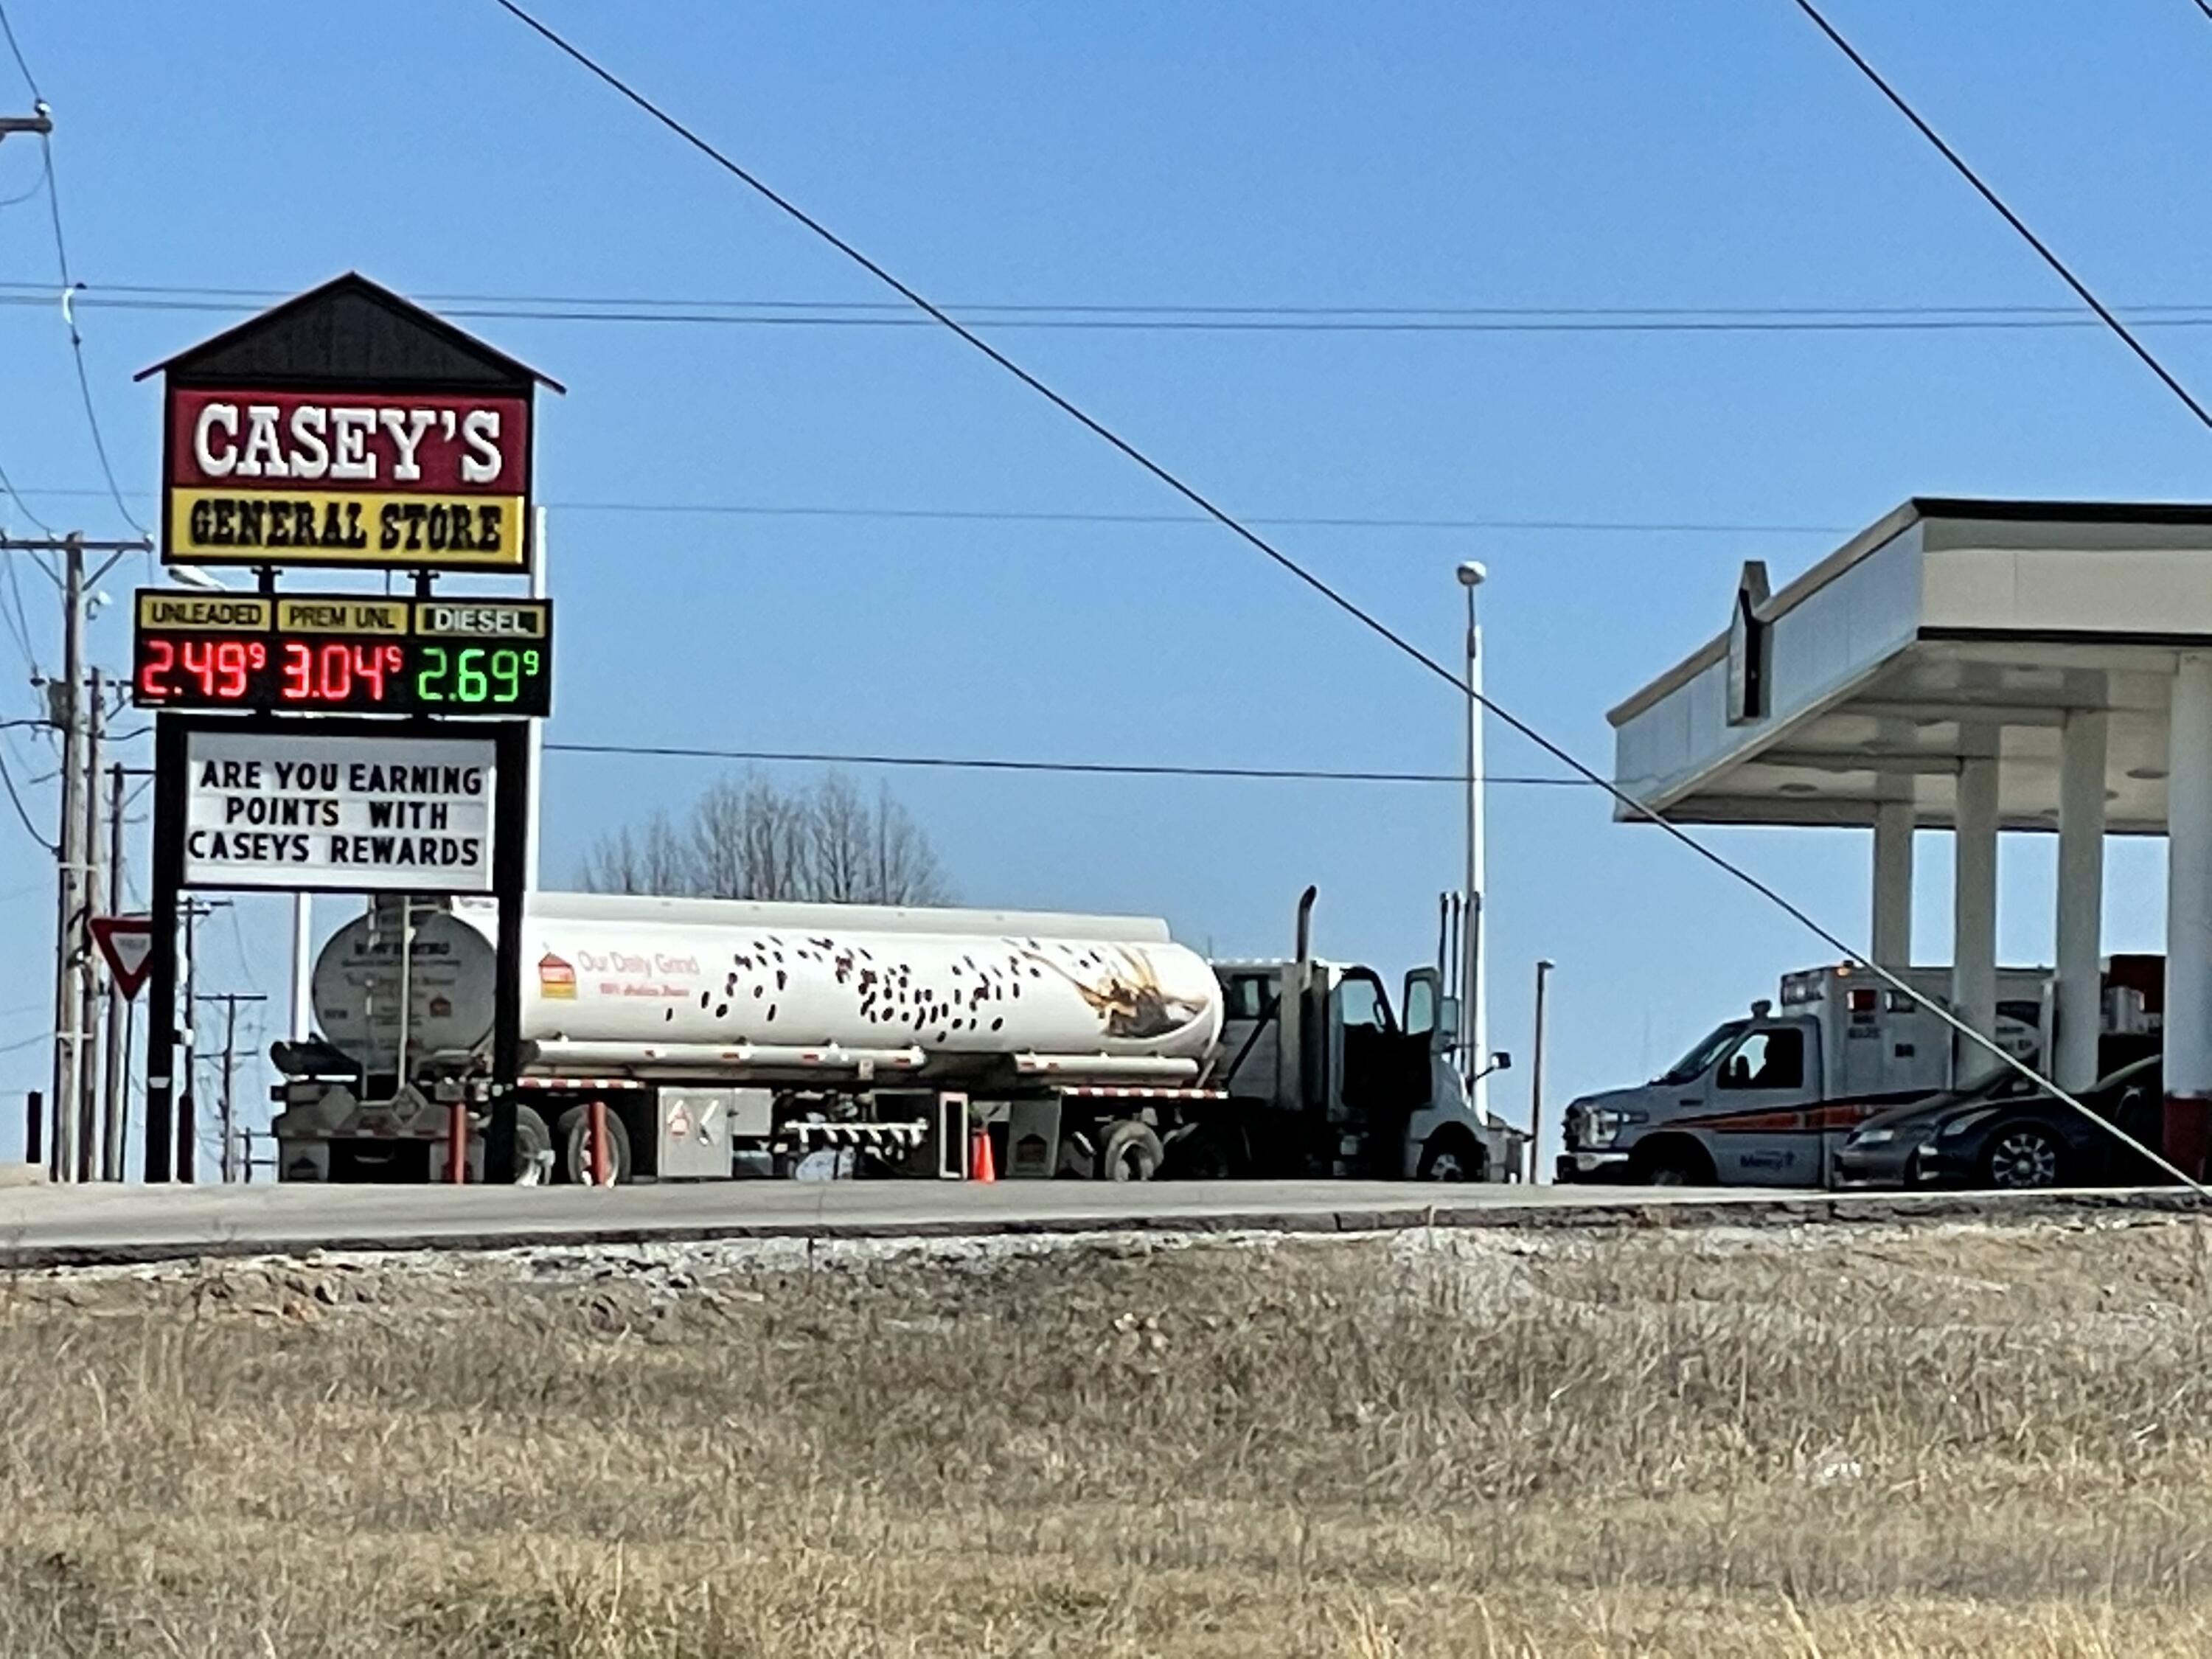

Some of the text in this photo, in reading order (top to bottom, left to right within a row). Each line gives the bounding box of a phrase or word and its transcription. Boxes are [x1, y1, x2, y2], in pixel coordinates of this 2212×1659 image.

[195, 403, 503, 484] CASEY'S
[189, 498, 503, 553] GENERAL STORE
[151, 602, 262, 626] UNLEADED
[290, 606, 396, 630] PREM UNL
[434, 608, 527, 633] DIESEL
[201, 760, 482, 795] ARE YOU EARNING
[225, 796, 448, 830] POINTS WITH
[187, 831, 479, 866] CASEYS REWARDS
